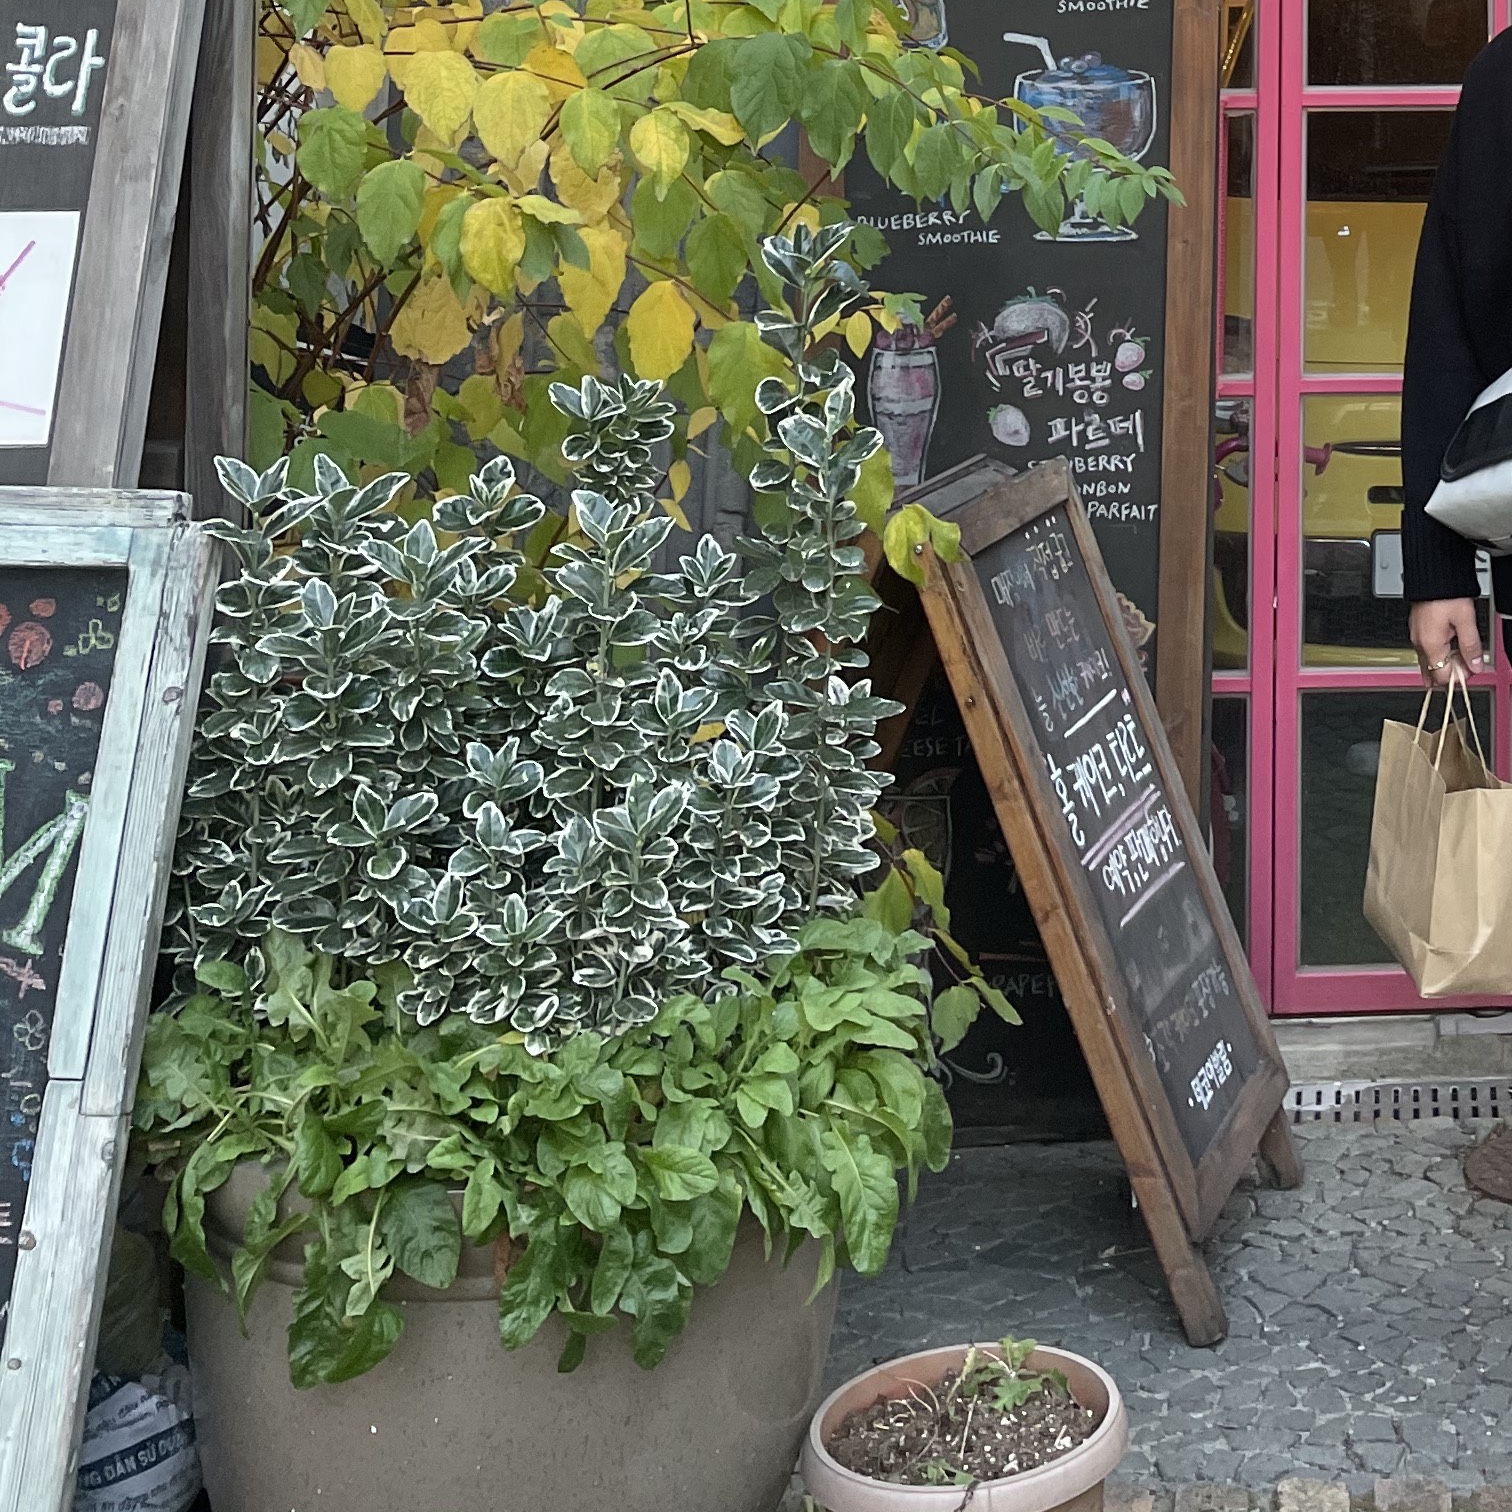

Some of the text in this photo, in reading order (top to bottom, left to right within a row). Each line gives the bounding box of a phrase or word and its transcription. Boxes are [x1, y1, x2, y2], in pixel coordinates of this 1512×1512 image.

[3, 22, 106, 117] 콜라
[917, 229, 1001, 246] SMOOTHIE
[1087, 501, 1158, 521] PARFAIT
